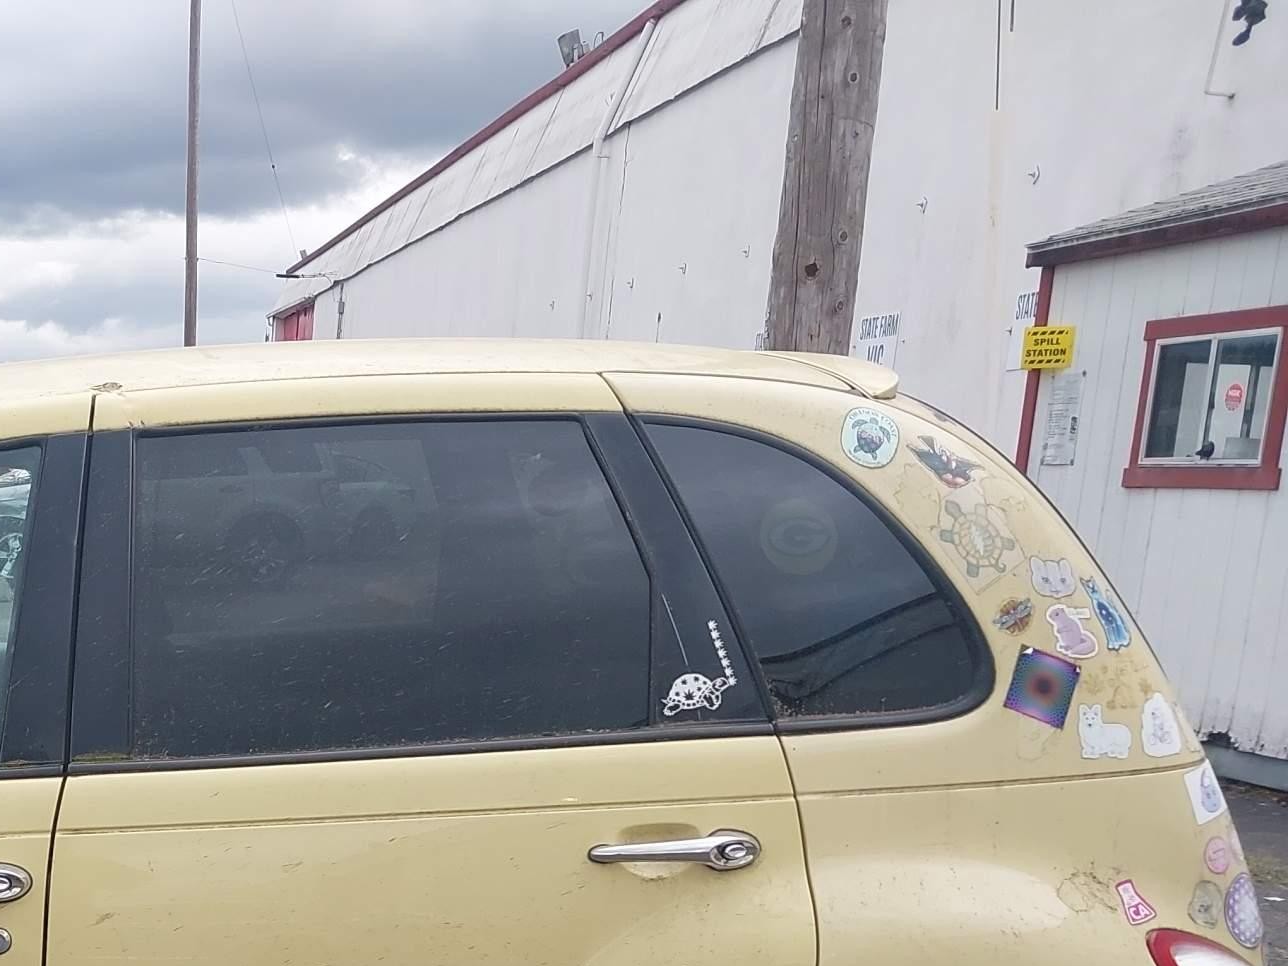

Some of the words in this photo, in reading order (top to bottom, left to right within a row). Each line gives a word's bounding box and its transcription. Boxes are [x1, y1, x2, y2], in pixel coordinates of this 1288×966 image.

[860, 317, 880, 341] STATE
[879, 313, 899, 338] FARM
[1033, 338, 1061, 347] SPILL
[1025, 348, 1067, 358] STATION
